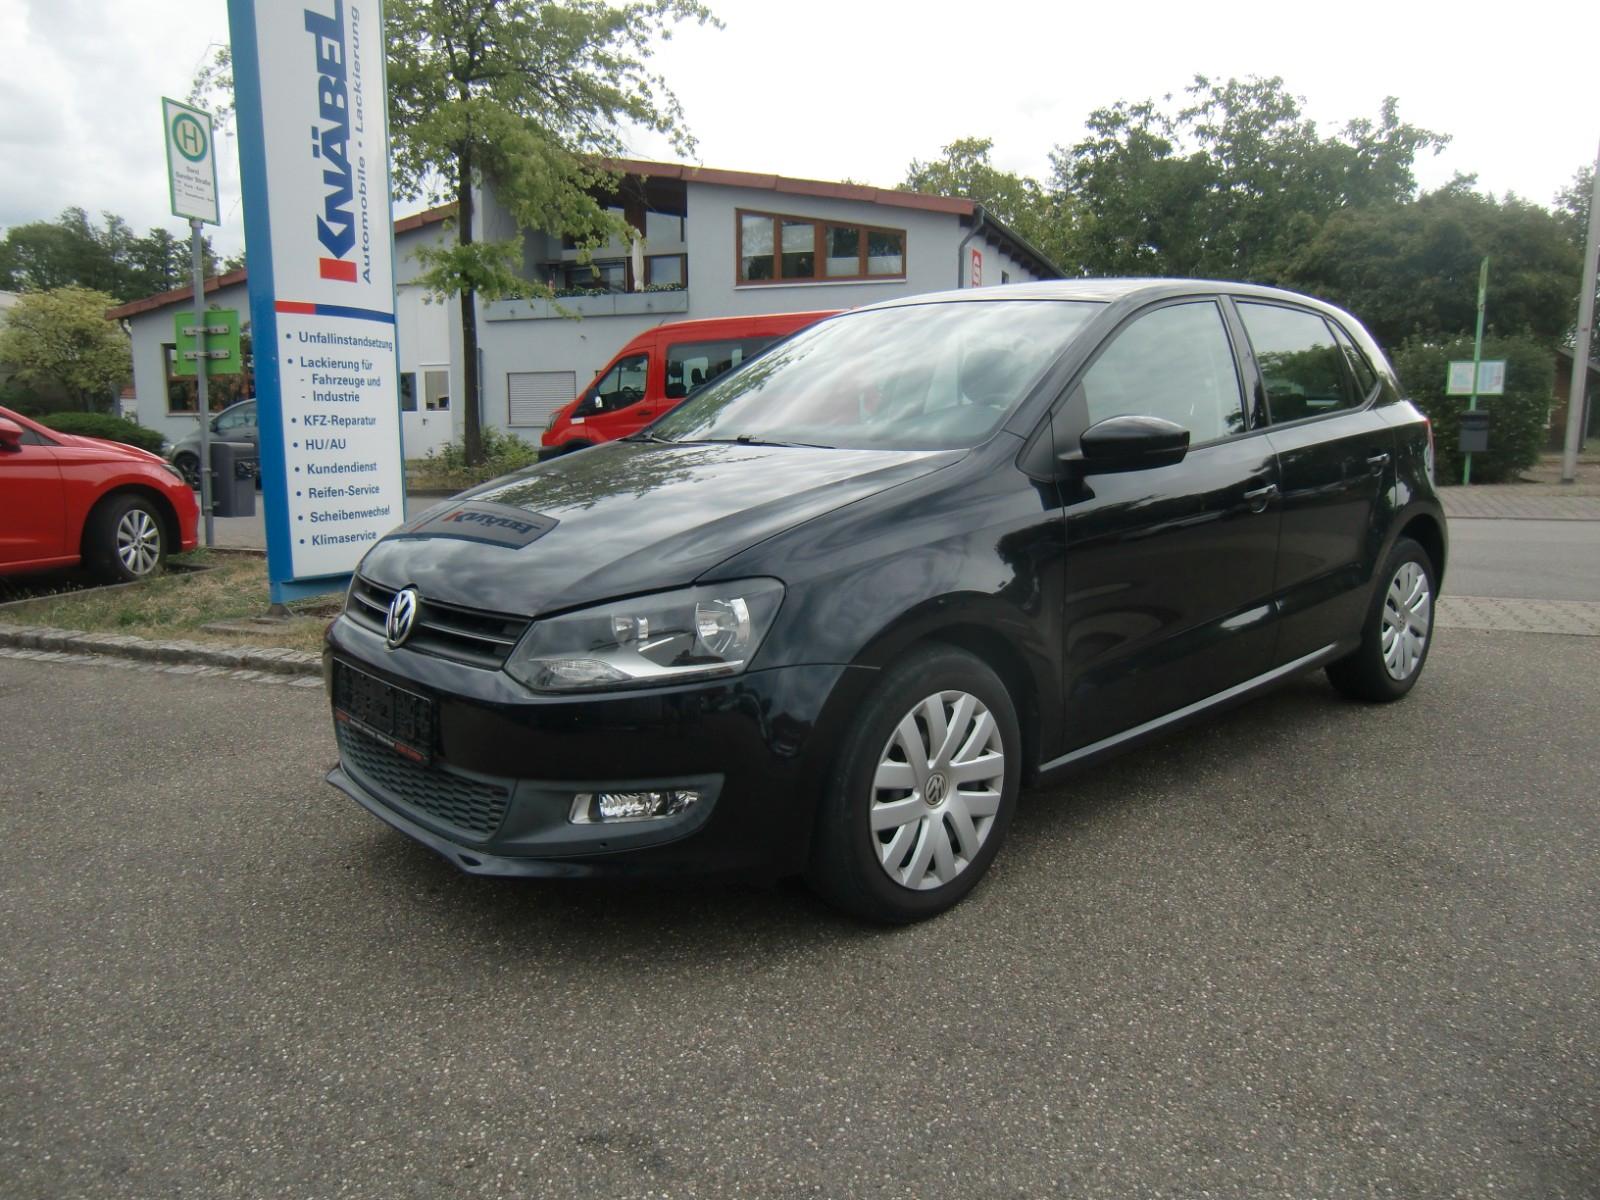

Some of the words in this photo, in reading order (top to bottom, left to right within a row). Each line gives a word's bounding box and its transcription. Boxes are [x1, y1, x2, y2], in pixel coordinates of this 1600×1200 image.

[352, 6, 364, 133] Lackierung
[183, 122, 198, 152] H
[304, 0, 357, 283] KNÄBEL
[358, 157, 371, 284] Automobile
[298, 331, 393, 352] Unfallinstandsetzung
[300, 356, 360, 372] Lackierung
[361, 359, 373, 370] für
[312, 373, 365, 388] Fahrzeuge
[367, 376, 381, 387] und
[313, 390, 360, 402] Industrie
[304, 415, 376, 428] KFZ-Reparatur
[305, 438, 347, 451] HU/AU
[307, 462, 377, 475] Kundendienst
[308, 484, 380, 499] Reifen-Service
[310, 504, 390, 523] Scheibenwechsel
[311, 530, 377, 546] Klimaservice
